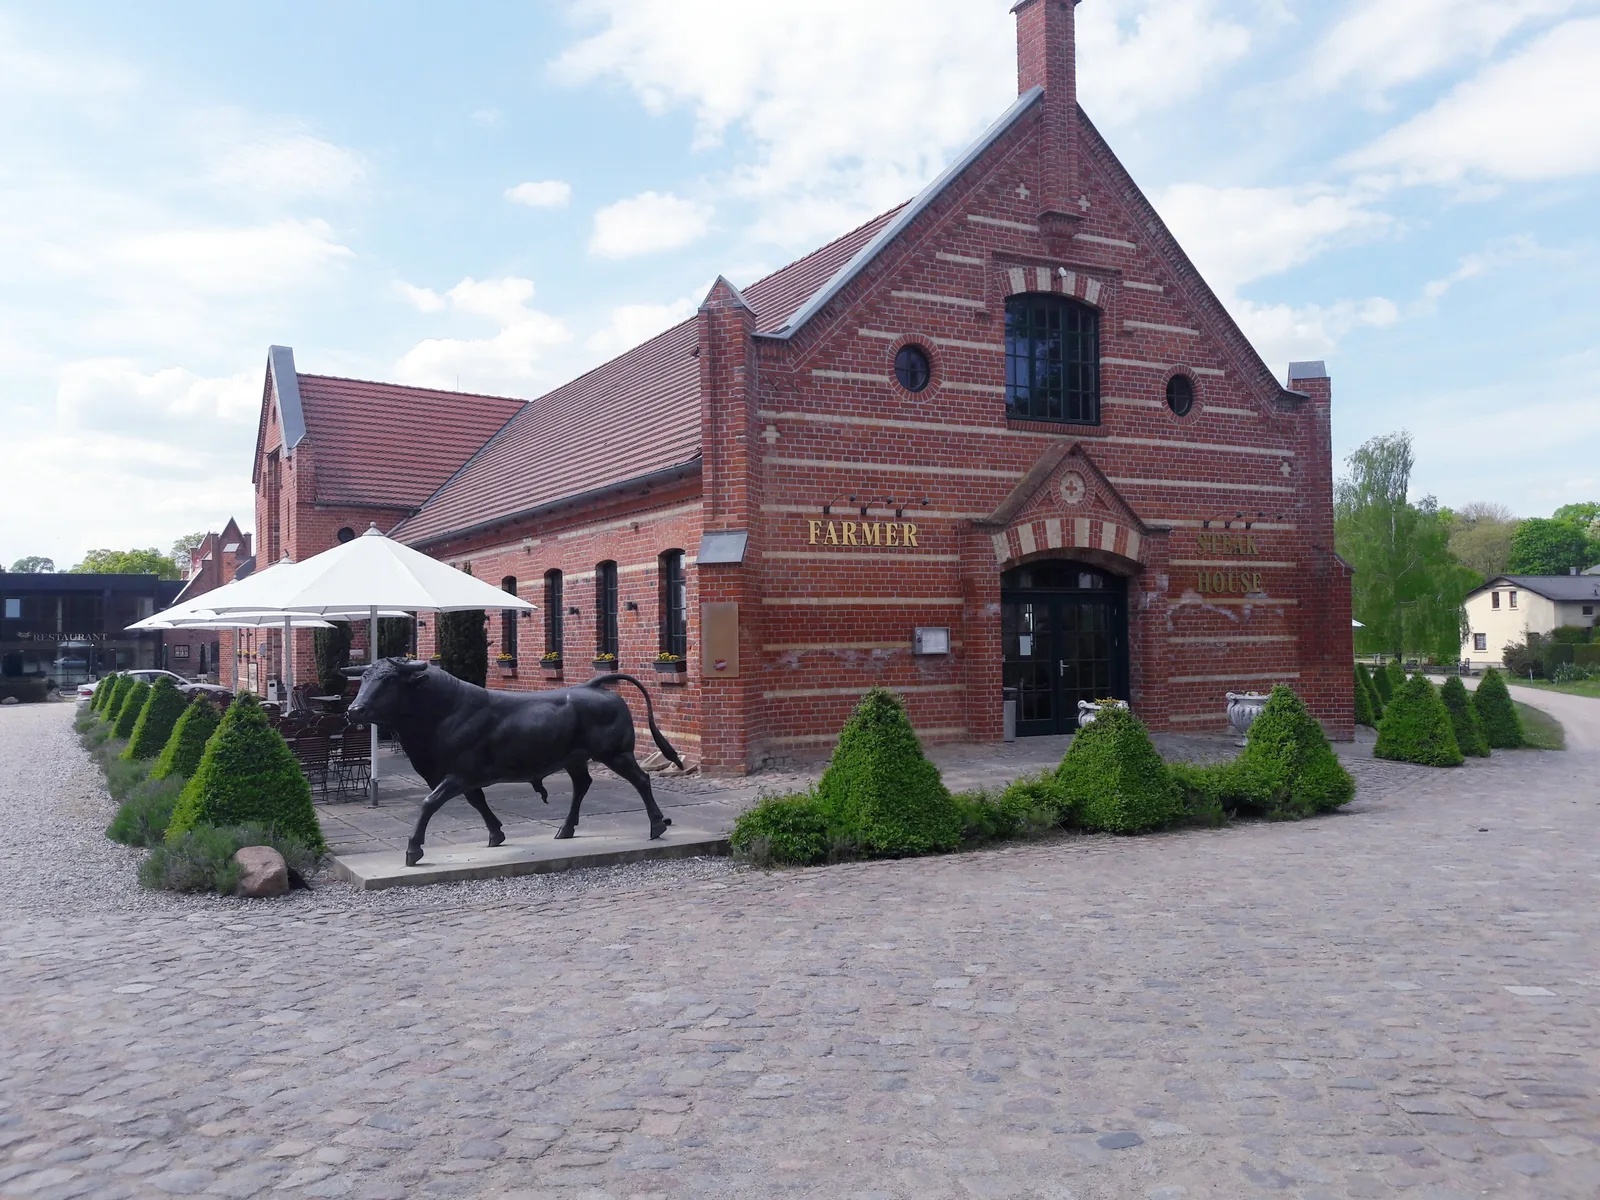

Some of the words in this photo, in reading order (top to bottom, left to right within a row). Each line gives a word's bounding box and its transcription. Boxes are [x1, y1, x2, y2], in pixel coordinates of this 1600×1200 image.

[808, 520, 919, 547] FARMER
[1197, 532, 1259, 555] STEAK
[1197, 571, 1262, 593] HOUSE
[33, 633, 108, 641] RESTAURANT
